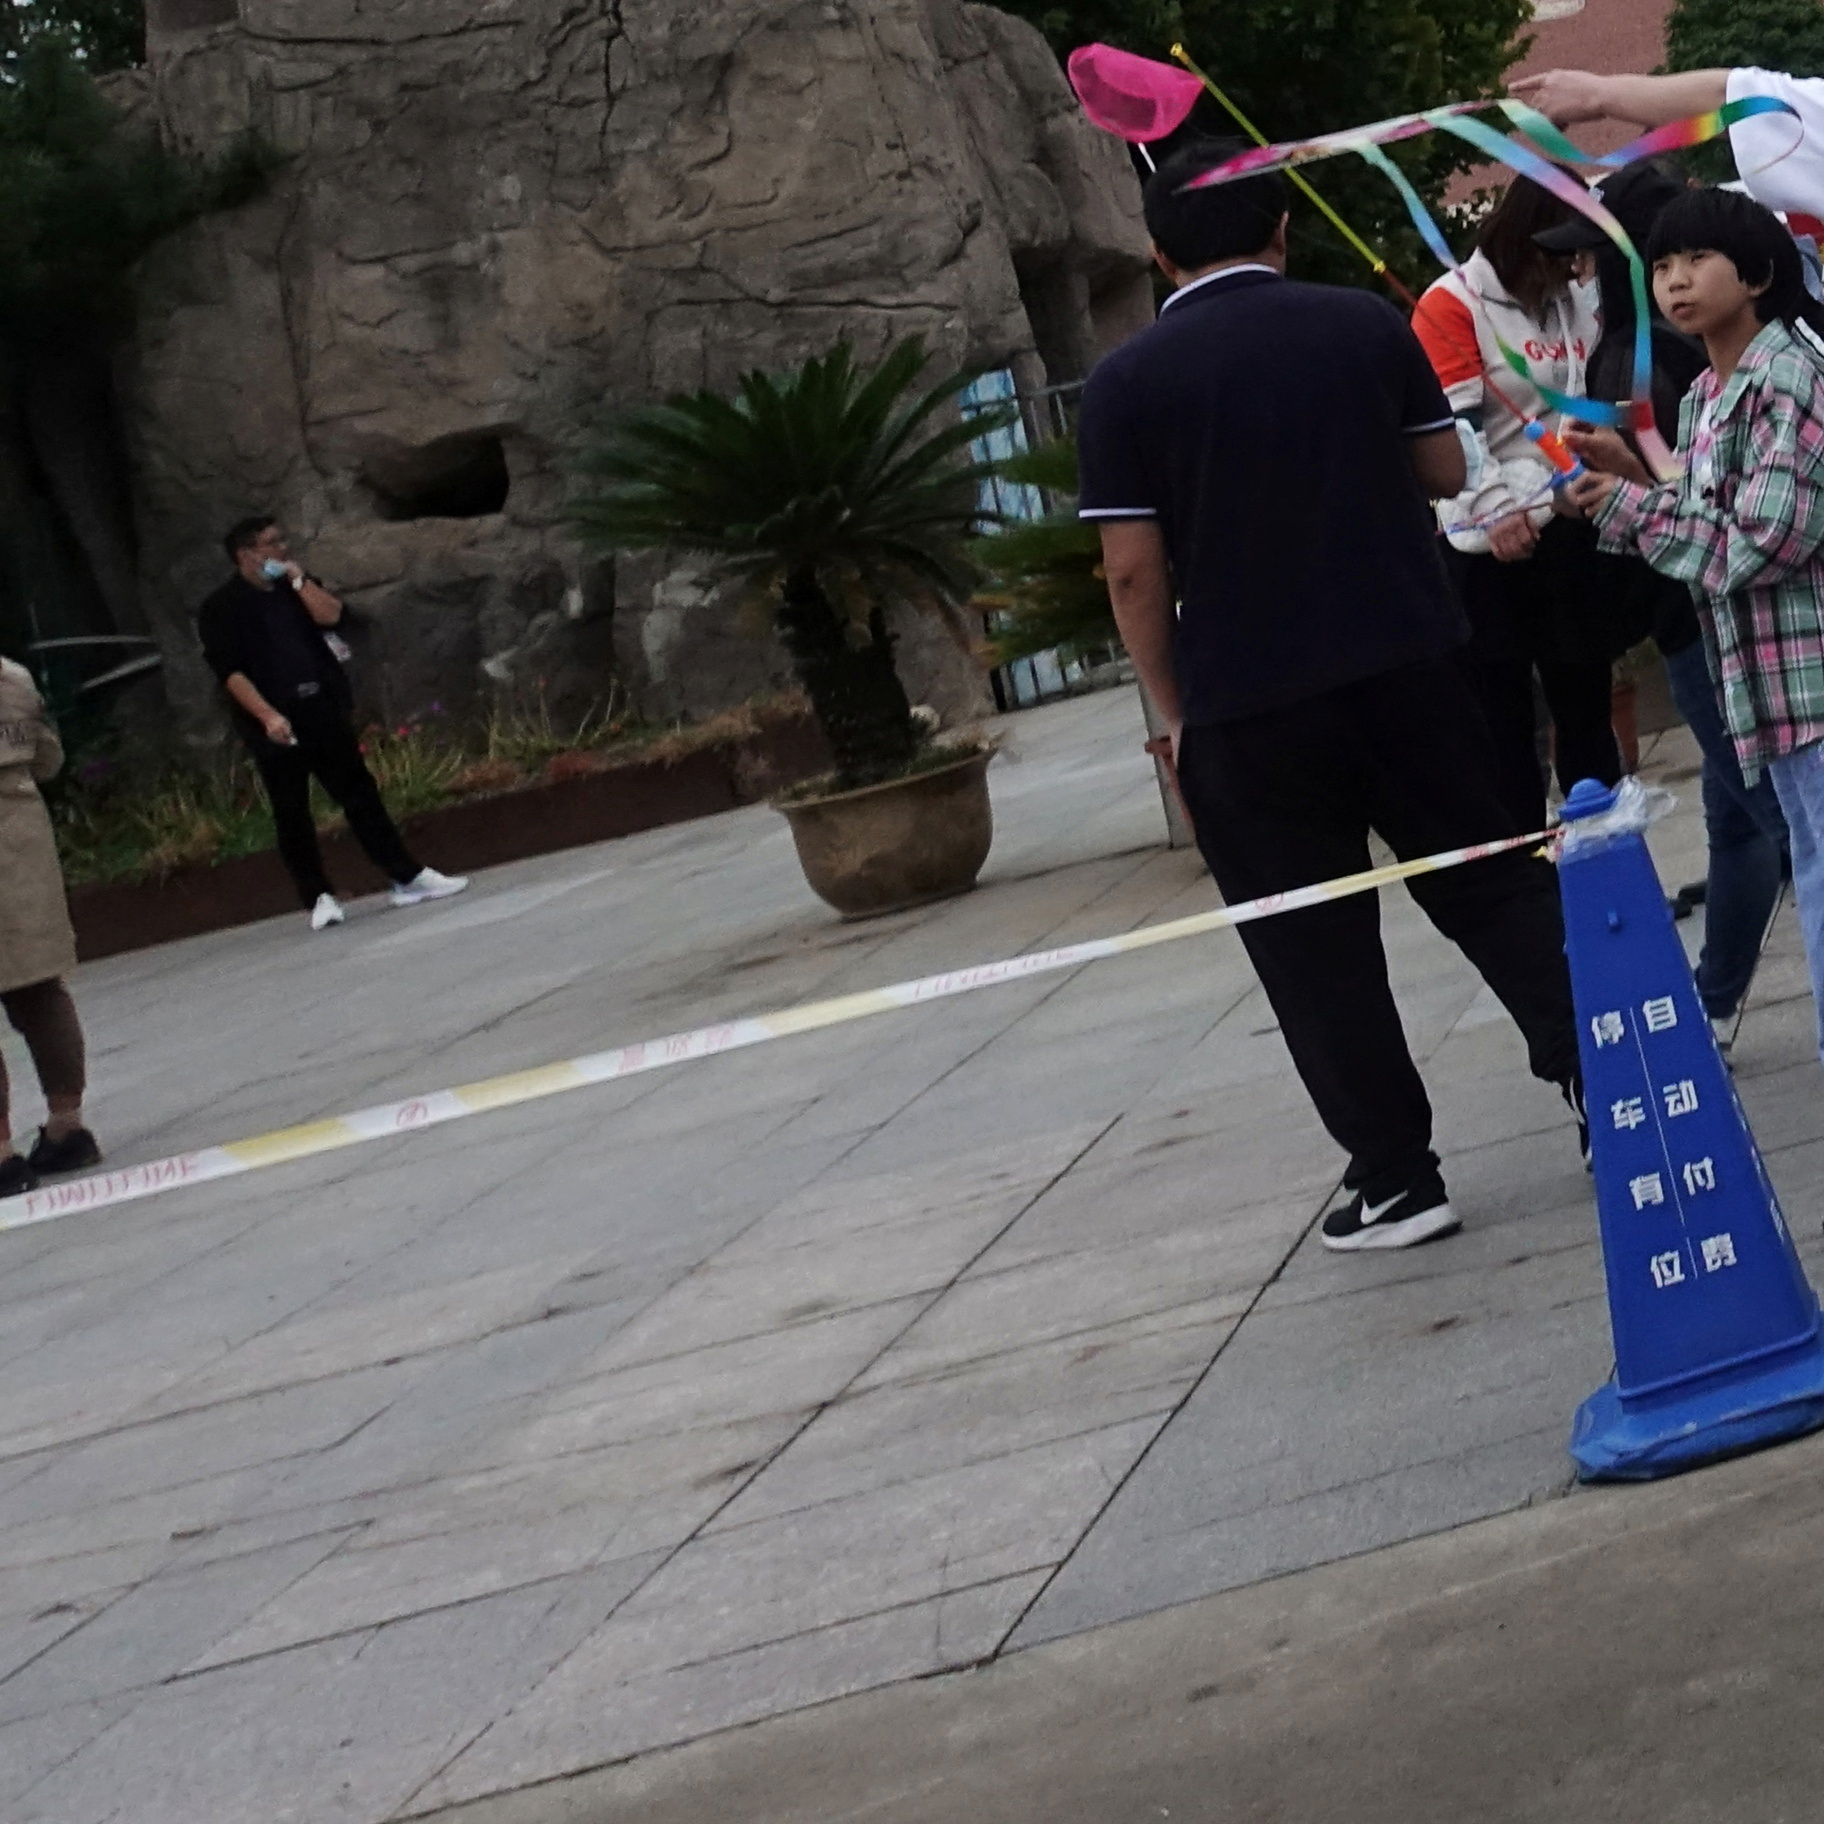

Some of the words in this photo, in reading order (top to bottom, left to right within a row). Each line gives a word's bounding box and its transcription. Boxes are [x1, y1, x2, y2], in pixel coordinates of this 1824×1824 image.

[1590, 1009, 1686, 1289] 停车有位
[1642, 994, 1738, 1273] 自动付费
